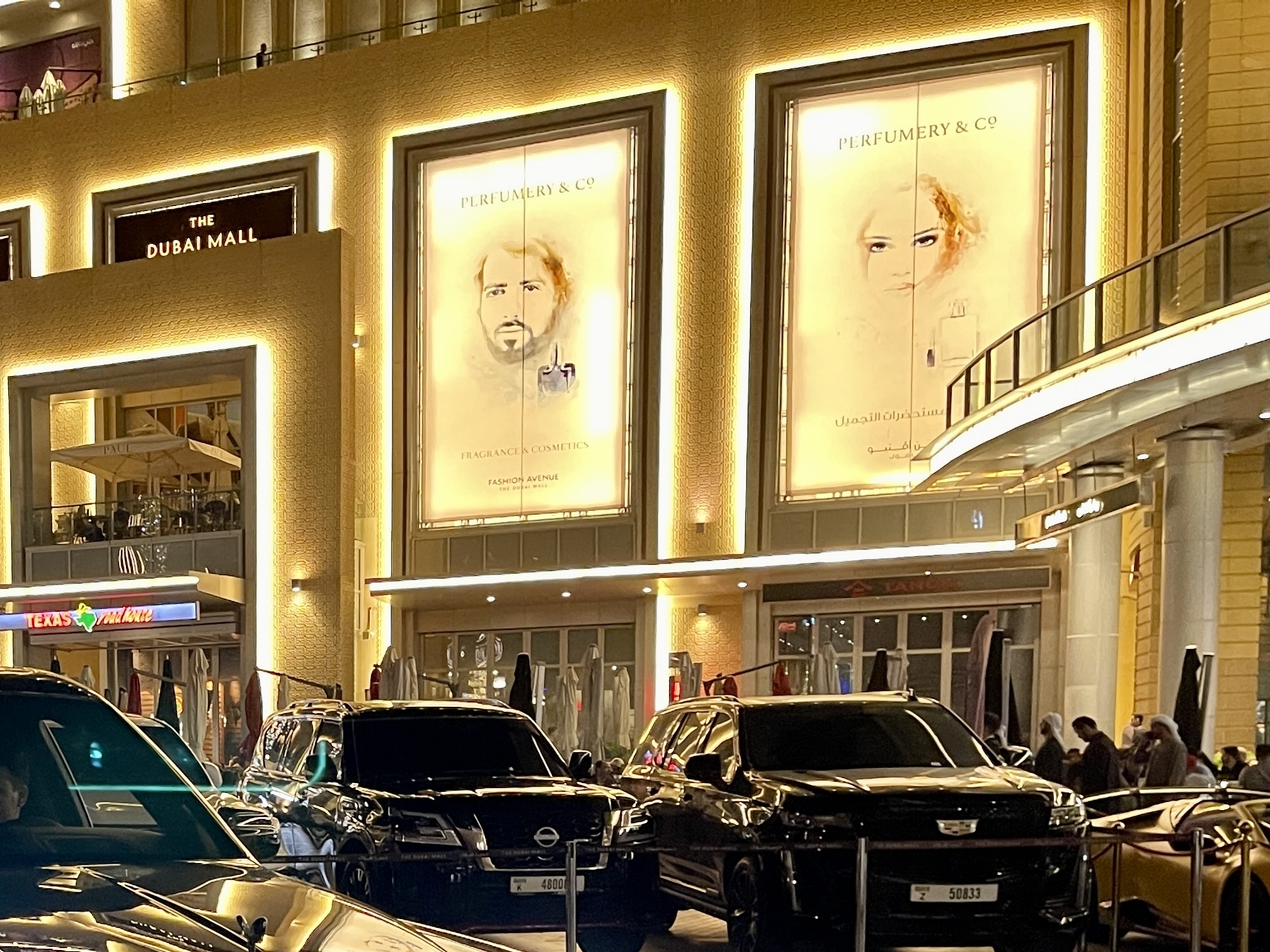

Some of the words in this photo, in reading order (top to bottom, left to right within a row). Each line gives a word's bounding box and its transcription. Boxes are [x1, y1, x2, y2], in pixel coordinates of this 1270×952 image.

[839, 122, 951, 150] PERFUMERY
[955, 120, 969, 134] &
[461, 183, 555, 208] PERFUMERY
[559, 181, 570, 194] &
[189, 214, 215, 229] THE
[146, 235, 202, 259] DUBAI
[207, 227, 258, 249] MALL
[834, 412, 882, 428] التجميل
[461, 446, 521, 460] FRAGRANCE
[531, 441, 589, 453] COSMETICS
[488, 476, 525, 486] FASHION
[526, 473, 559, 483] AVENUE
[26, 612, 73, 629] TEXAS
[949, 888, 981, 900] 50833
